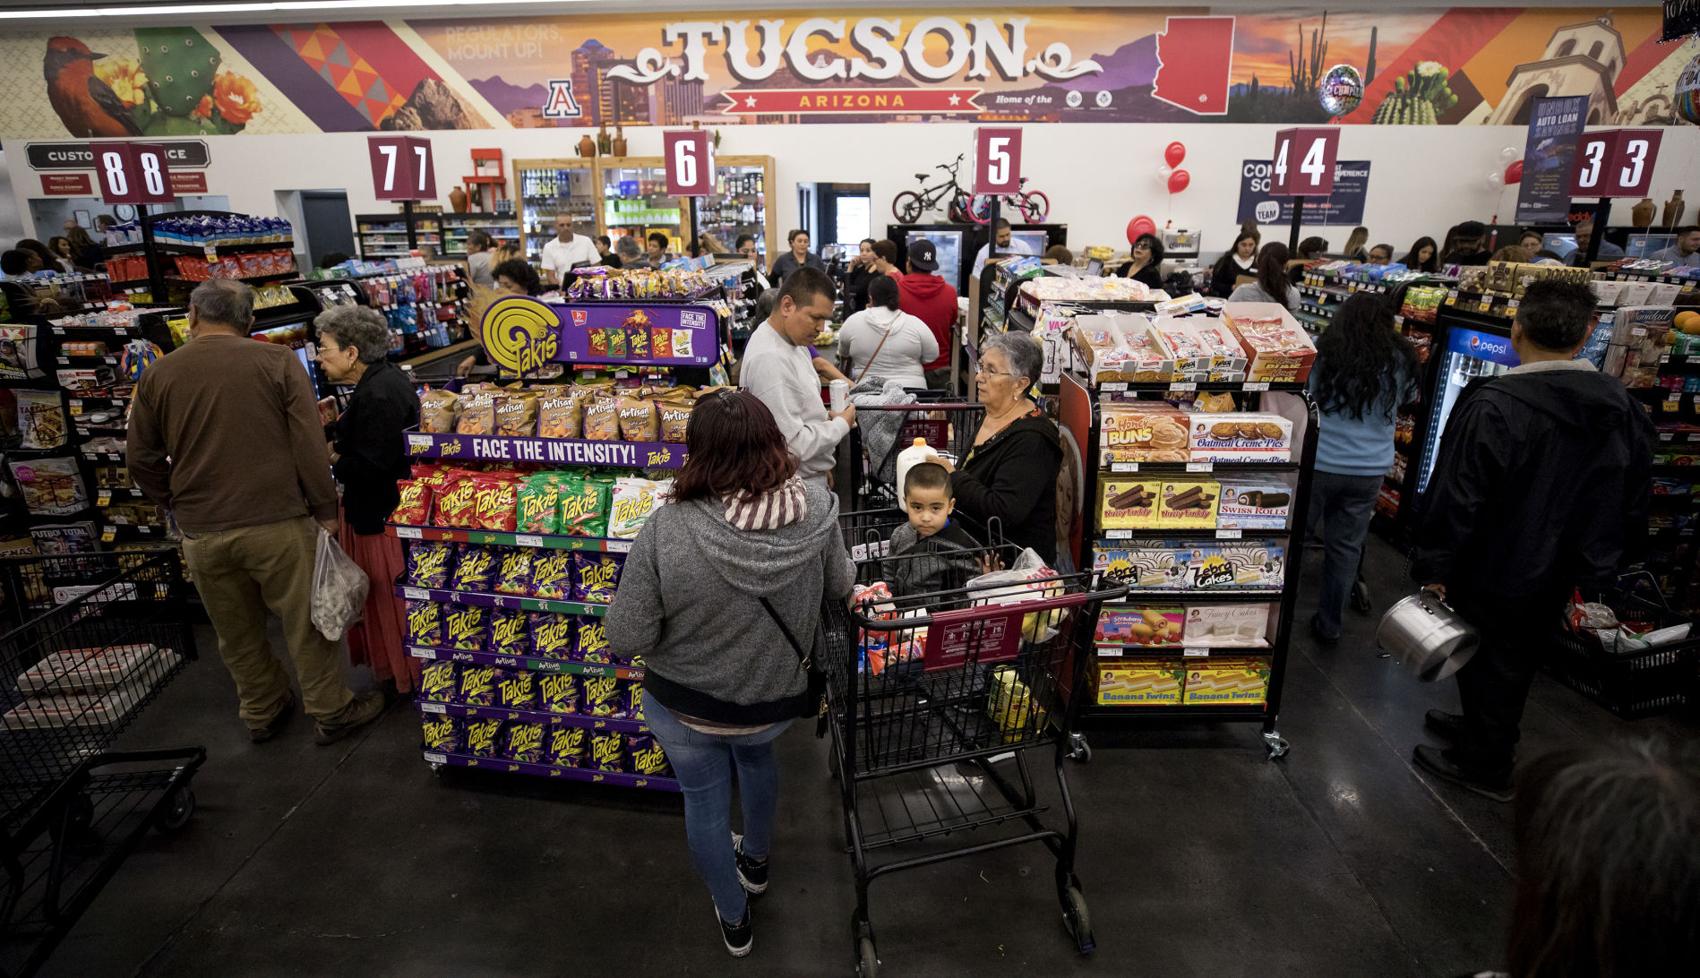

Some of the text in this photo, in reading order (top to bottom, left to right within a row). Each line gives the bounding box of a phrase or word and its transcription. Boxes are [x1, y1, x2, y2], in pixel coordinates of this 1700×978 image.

[448, 41, 543, 60] MOUNT UP!
[664, 17, 1030, 82] TUCSON
[543, 80, 582, 118] A
[800, 94, 906, 108] ARIZONA
[996, 95, 1052, 105] Home of the
[1537, 113, 1578, 127] AUTO LOAN
[48, 151, 94, 161] CUSTO
[378, 145, 397, 191] 7
[674, 140, 696, 187] 6
[988, 137, 1011, 185] 5
[1275, 139, 1289, 186] 4
[1300, 138, 1327, 186] 4
[1579, 141, 1606, 188] 3
[1619, 139, 1649, 188] 3
[102, 152, 128, 195] 8
[140, 152, 164, 195] 8
[1258, 209, 1277, 220] TEAM
[510, 333, 557, 379] Takis
[1480, 342, 1507, 354] pepsi
[542, 399, 574, 410] Artisan
[620, 407, 649, 418] Artisan
[440, 442, 461, 457] Takis
[473, 438, 636, 464] FACE THE INTENSITY!
[1108, 428, 1152, 446] BUNS
[1197, 438, 1284, 448] Oatmeal Creme Pies
[647, 450, 672, 466] Takis
[440, 482, 474, 517] Takis
[474, 487, 513, 517] Takis
[521, 489, 558, 522] Takis
[562, 491, 598, 524] Takis
[613, 494, 653, 528] Takis
[580, 562, 616, 590] Takis
[1190, 562, 1233, 588] Zebra
[1197, 573, 1233, 587] Cakes
[408, 606, 438, 638] Takis
[446, 609, 482, 640] Takis
[492, 615, 526, 644] Takis
[535, 619, 569, 651] Takis
[422, 665, 453, 693] Takis
[461, 667, 495, 695] Takis
[499, 677, 532, 704] Takis
[539, 673, 573, 703] Takis
[583, 677, 617, 705] Takis
[1103, 692, 1176, 700] Banana Twins
[1189, 691, 1261, 700] Banana Twins
[422, 721, 453, 747] Takis
[468, 721, 499, 749] Takis
[509, 722, 543, 751] Takis
[551, 729, 584, 754] Takis
[592, 733, 621, 762] Takis
[632, 748, 664, 772] Takis
